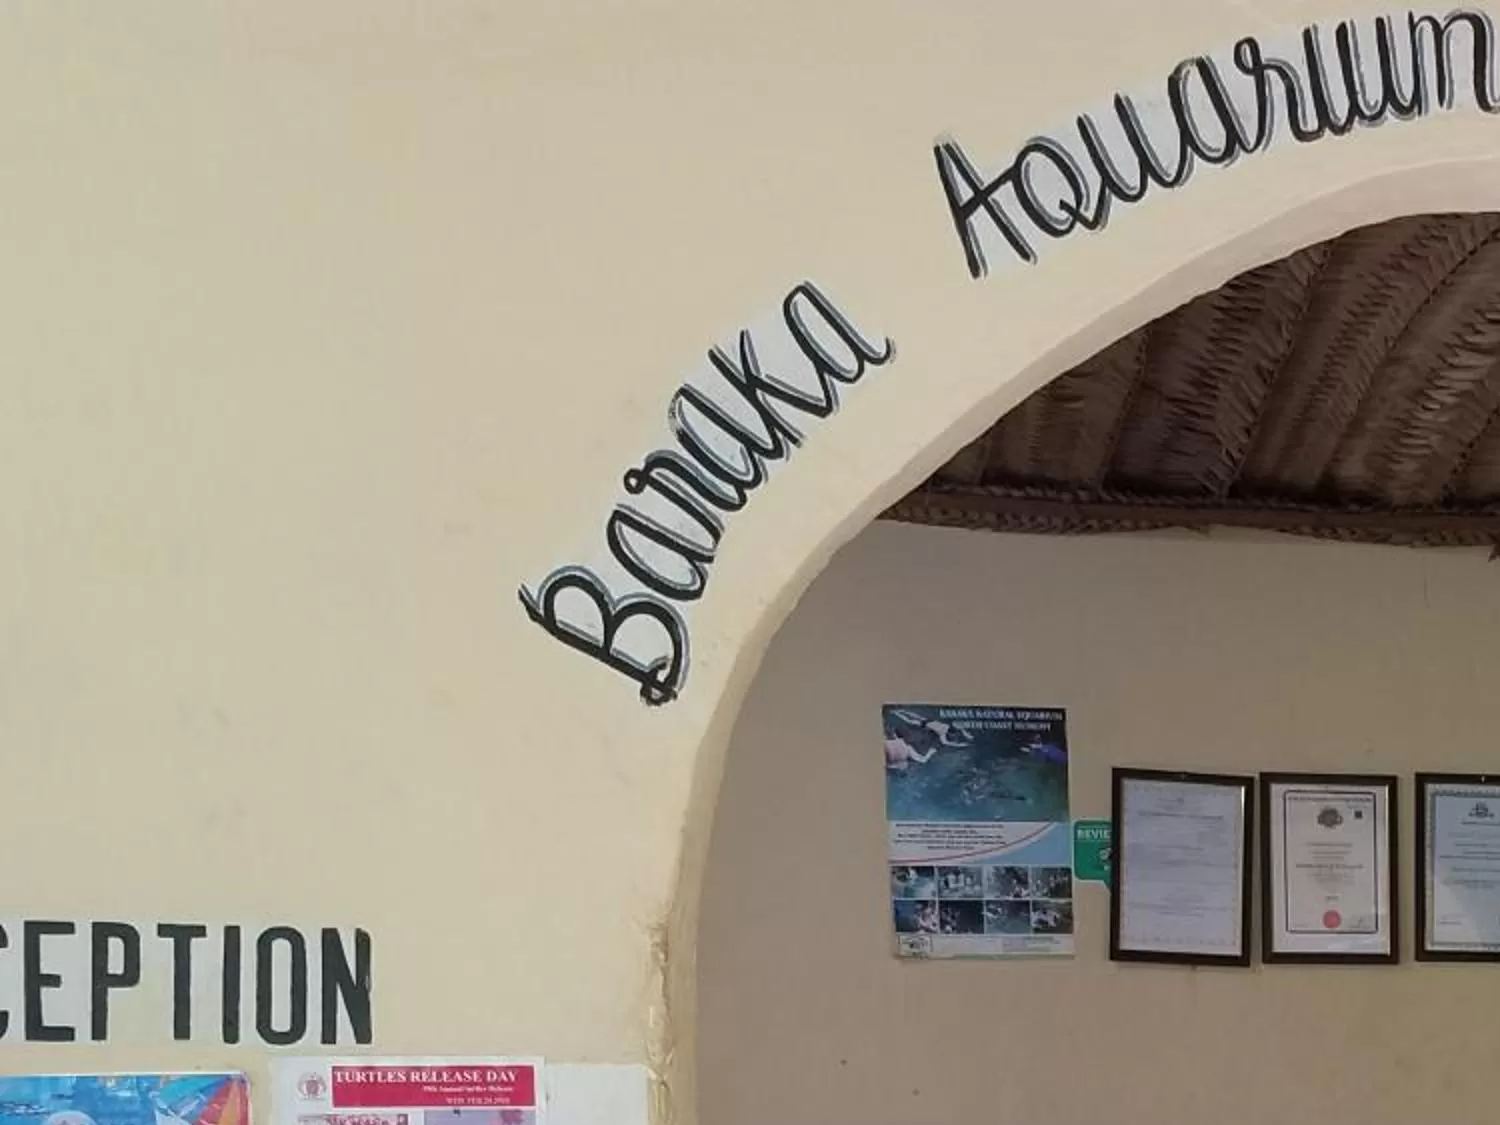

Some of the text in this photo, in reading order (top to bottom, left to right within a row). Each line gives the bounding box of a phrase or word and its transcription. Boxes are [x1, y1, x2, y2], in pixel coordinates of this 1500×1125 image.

[518, 281, 896, 706] Baraka
[1077, 828, 1111, 841] REVIE
[0, 920, 373, 1046] EPTION
[334, 1070, 518, 1083] TURTLES RELEASE DAY
